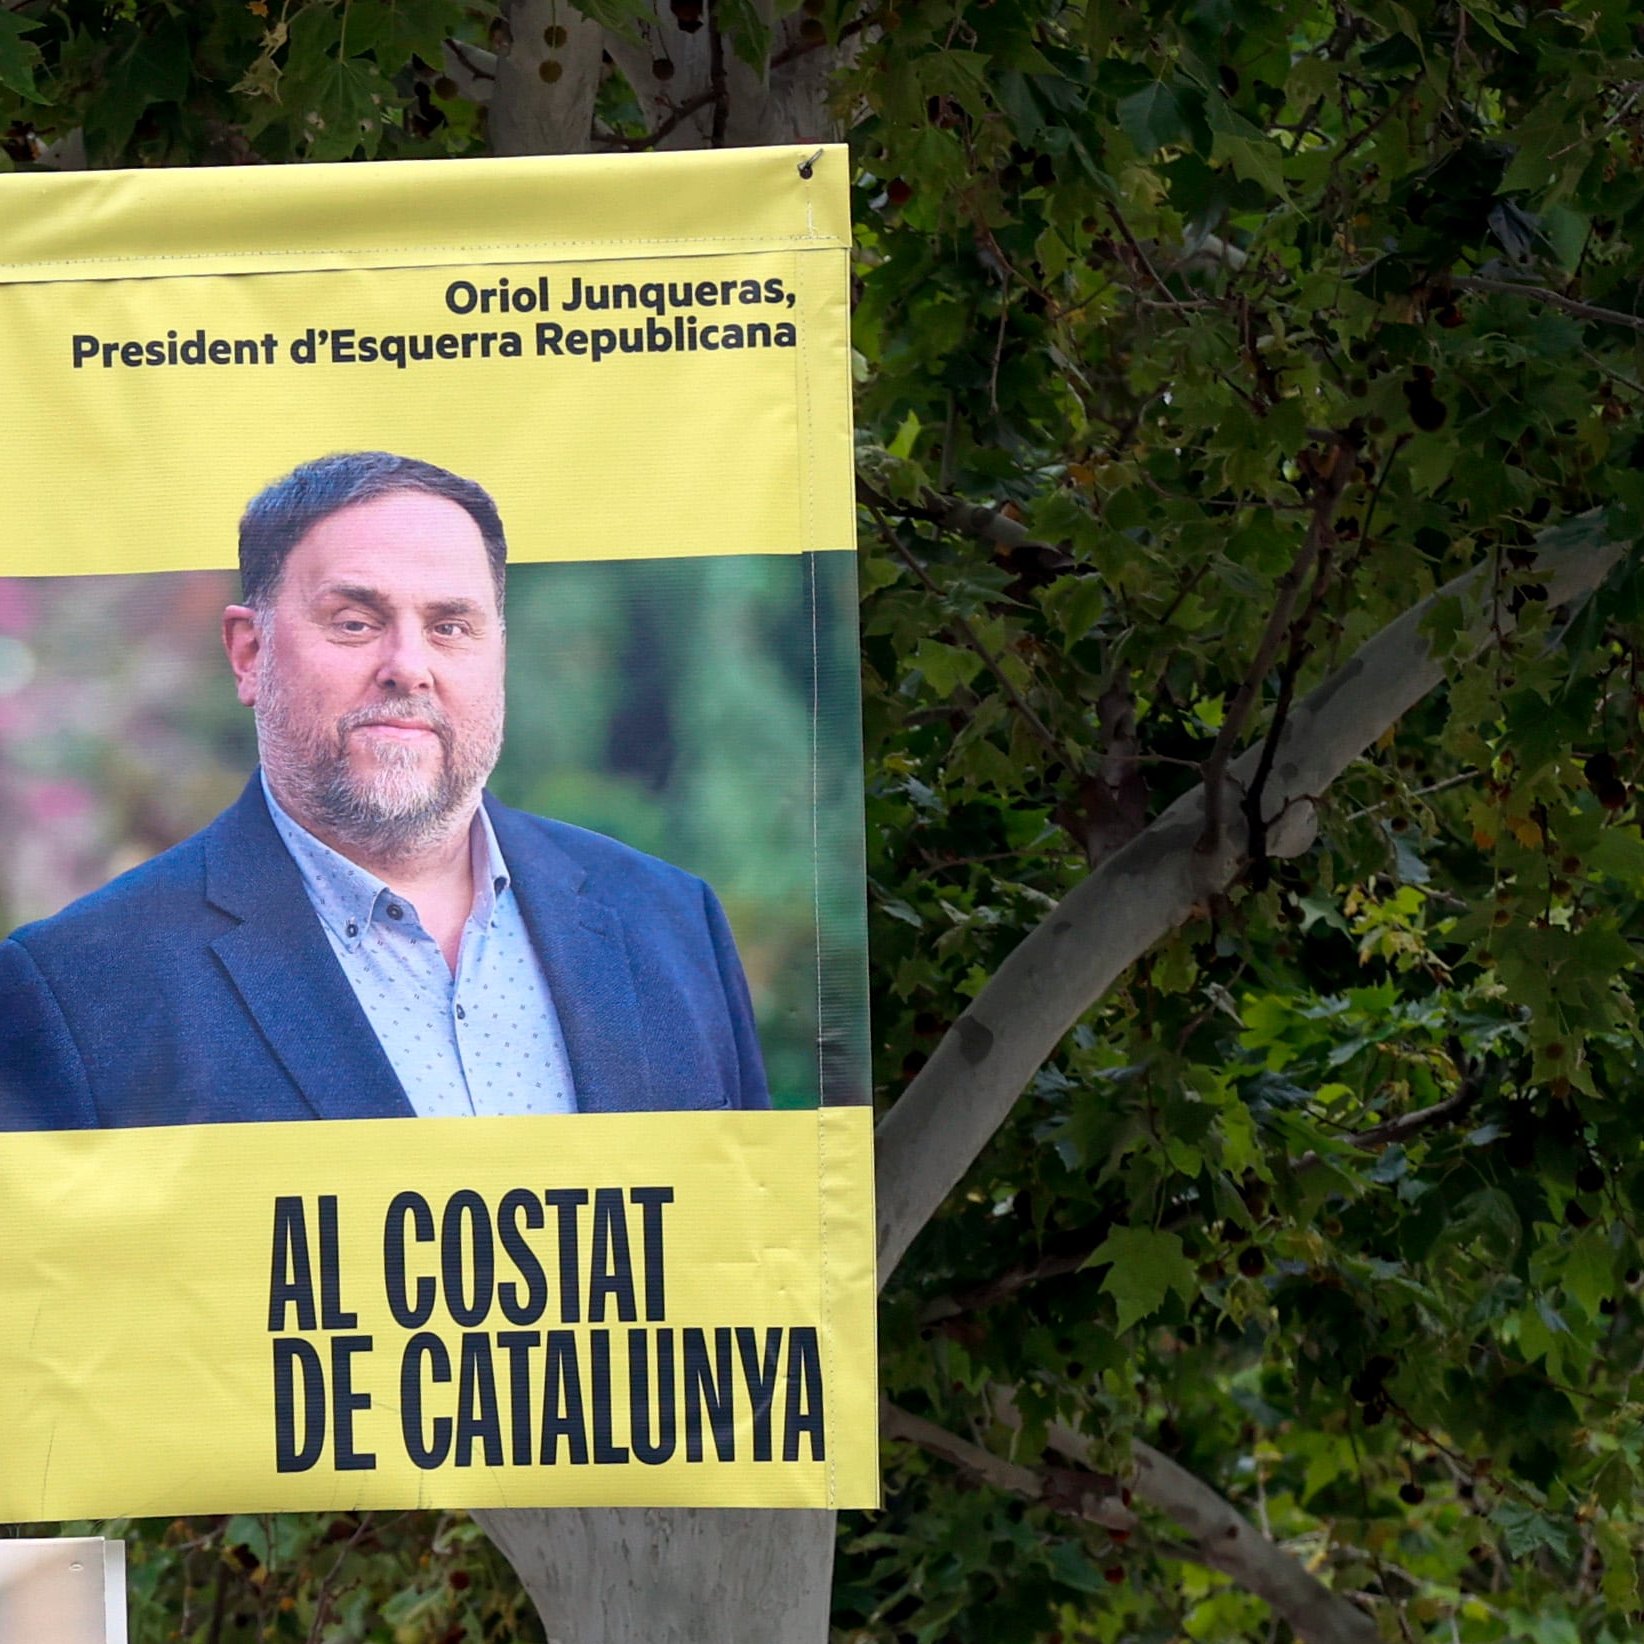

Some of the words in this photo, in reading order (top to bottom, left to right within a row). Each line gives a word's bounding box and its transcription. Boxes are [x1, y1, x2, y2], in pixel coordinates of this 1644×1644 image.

[73, 331, 278, 369] President
[536, 316, 797, 357] Republicana
[445, 277, 550, 314] Oriol
[562, 276, 797, 312] Junqueras,
[268, 1195, 357, 1331] AL
[384, 1187, 674, 1329] COSTAT
[273, 1335, 376, 1473] DE
[401, 1327, 825, 1469] CATALUNYA
